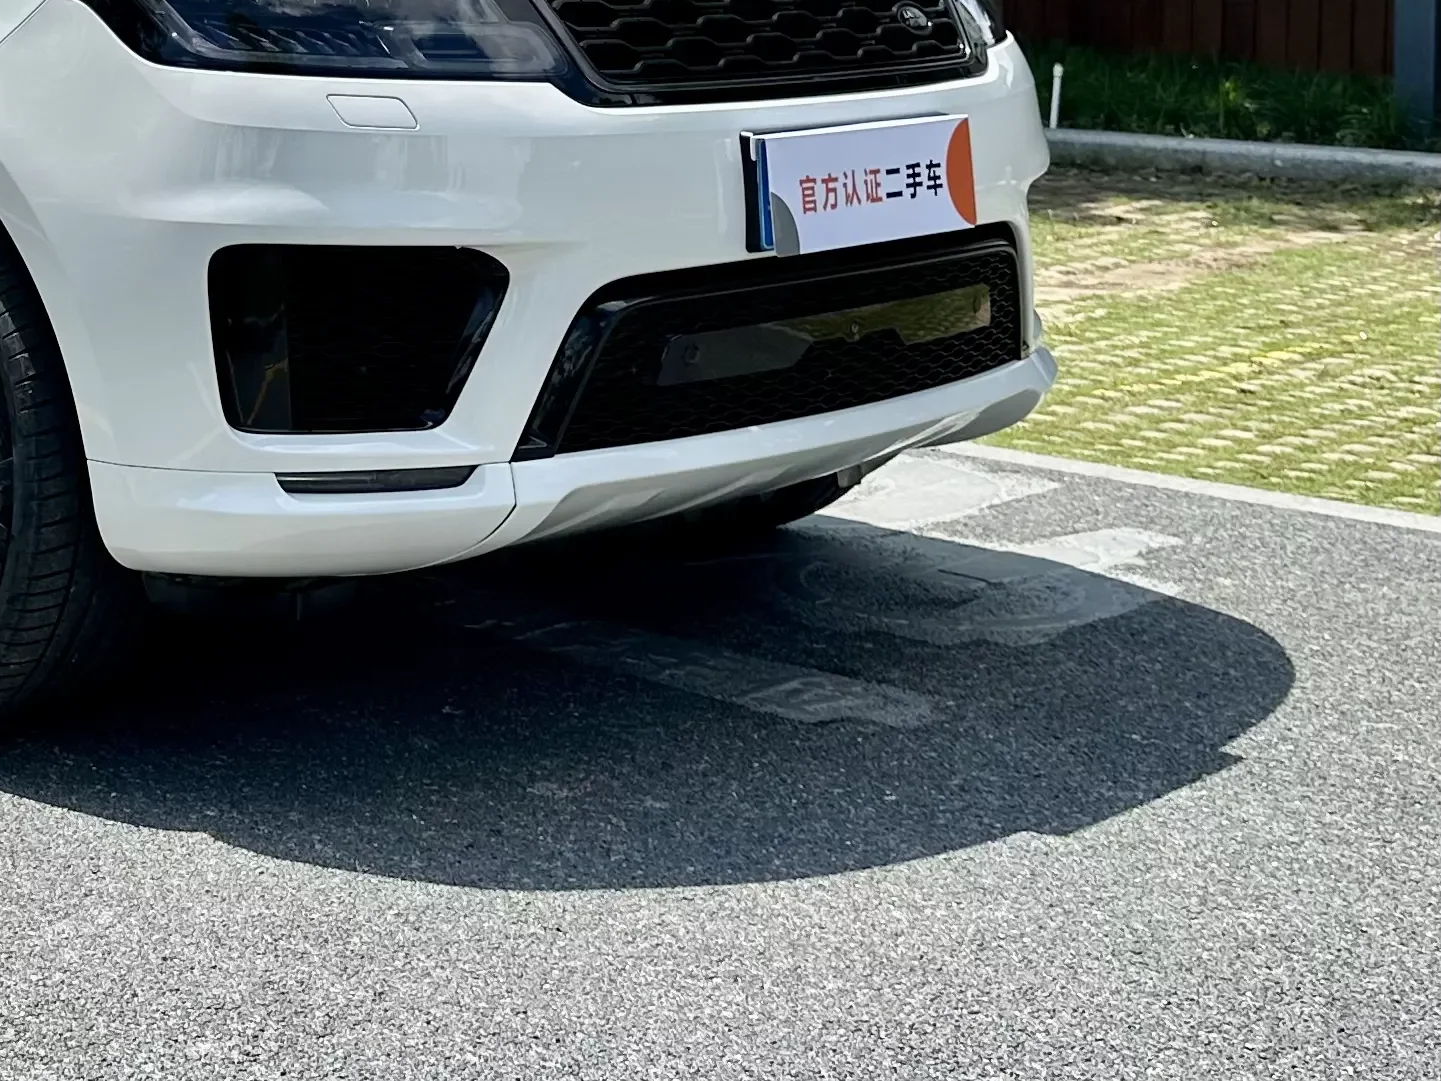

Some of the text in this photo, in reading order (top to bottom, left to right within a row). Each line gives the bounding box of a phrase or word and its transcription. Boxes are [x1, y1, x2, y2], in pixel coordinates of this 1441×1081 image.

[798, 159, 944, 215] 官方认证二手车
